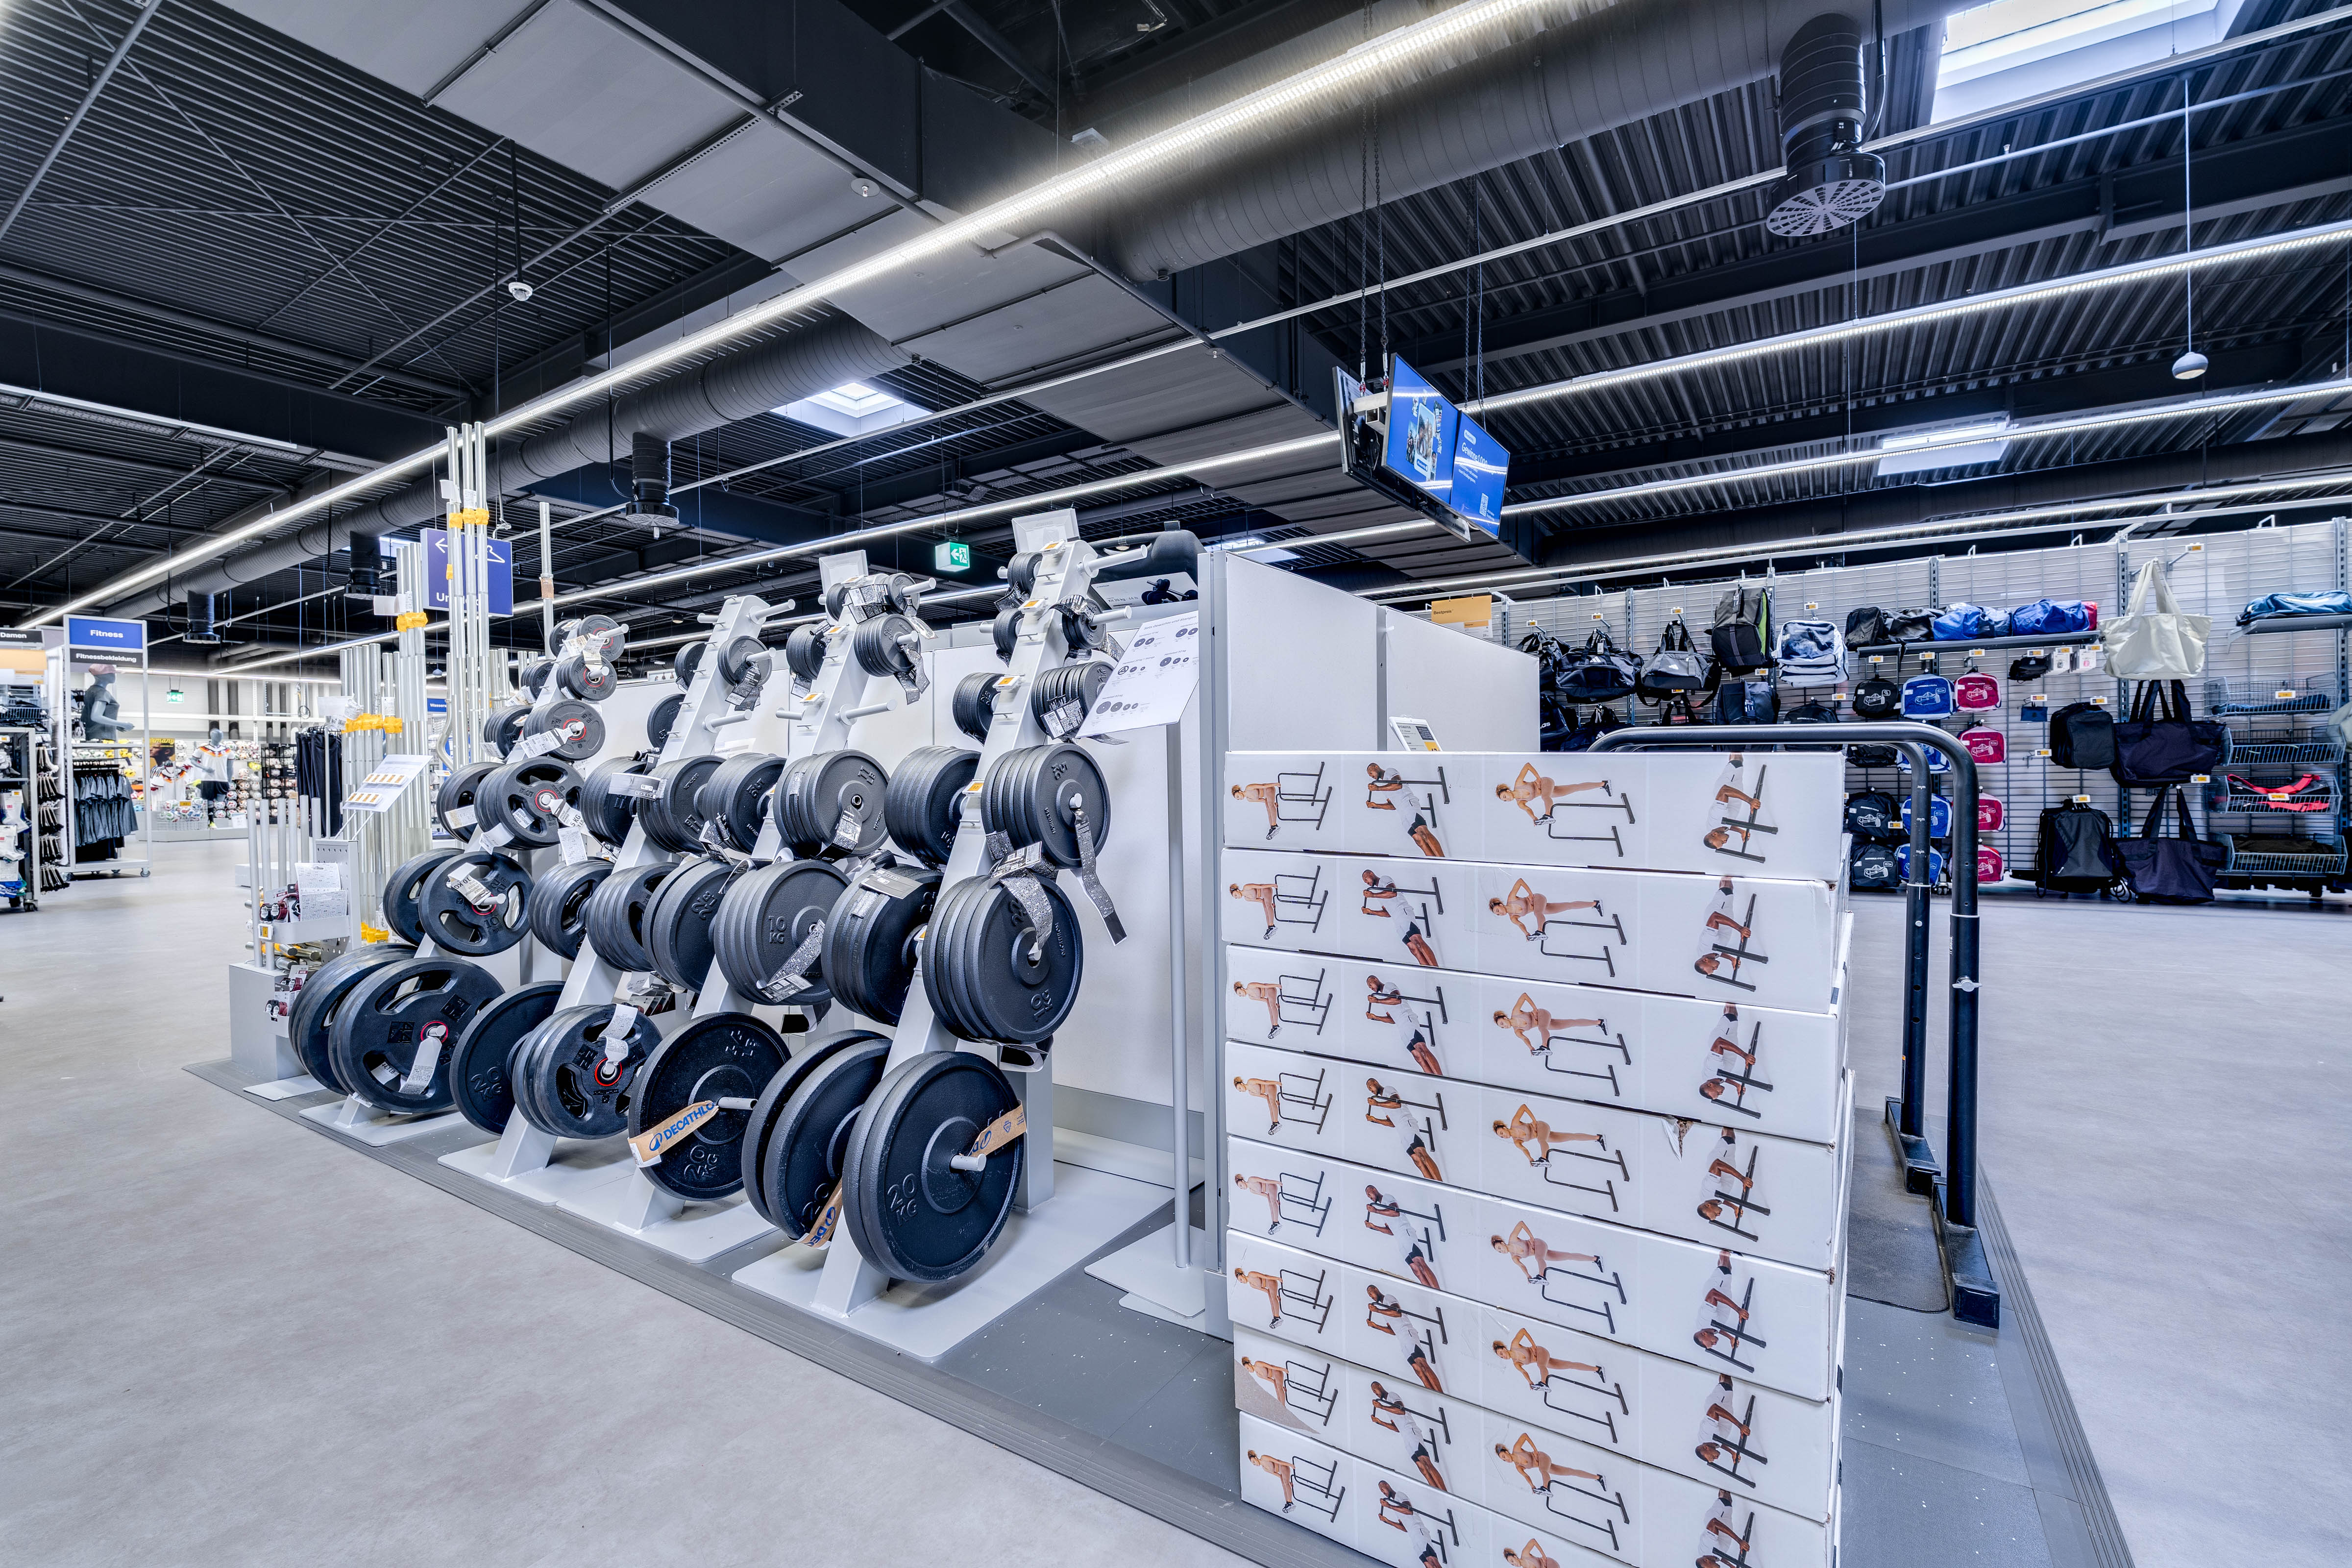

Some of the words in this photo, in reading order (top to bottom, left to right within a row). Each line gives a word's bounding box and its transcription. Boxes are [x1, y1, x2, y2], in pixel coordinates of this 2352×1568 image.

[1462, 442, 1478, 461] Gewinne
[90, 630, 123, 638] Fitness
[76, 653, 137, 663] Fitnessbekleidung
[573, 814, 581, 823] KG
[491, 878, 507, 893] 22
[691, 897, 713, 920] 22
[484, 916, 499, 929] 10
[768, 915, 787, 932] 10
[769, 932, 785, 944] KG
[1054, 922, 1066, 957] DECATHLON
[1030, 993, 1045, 1022] 10
[1041, 989, 1054, 1012] KG
[470, 1066, 503, 1092] 20
[479, 1083, 503, 1102] KG
[662, 1102, 717, 1141] DECATHLO
[684, 1145, 706, 1180] 20
[697, 1153, 718, 1177] KG
[887, 1173, 918, 1212] 20
[895, 1198, 918, 1227] KG
